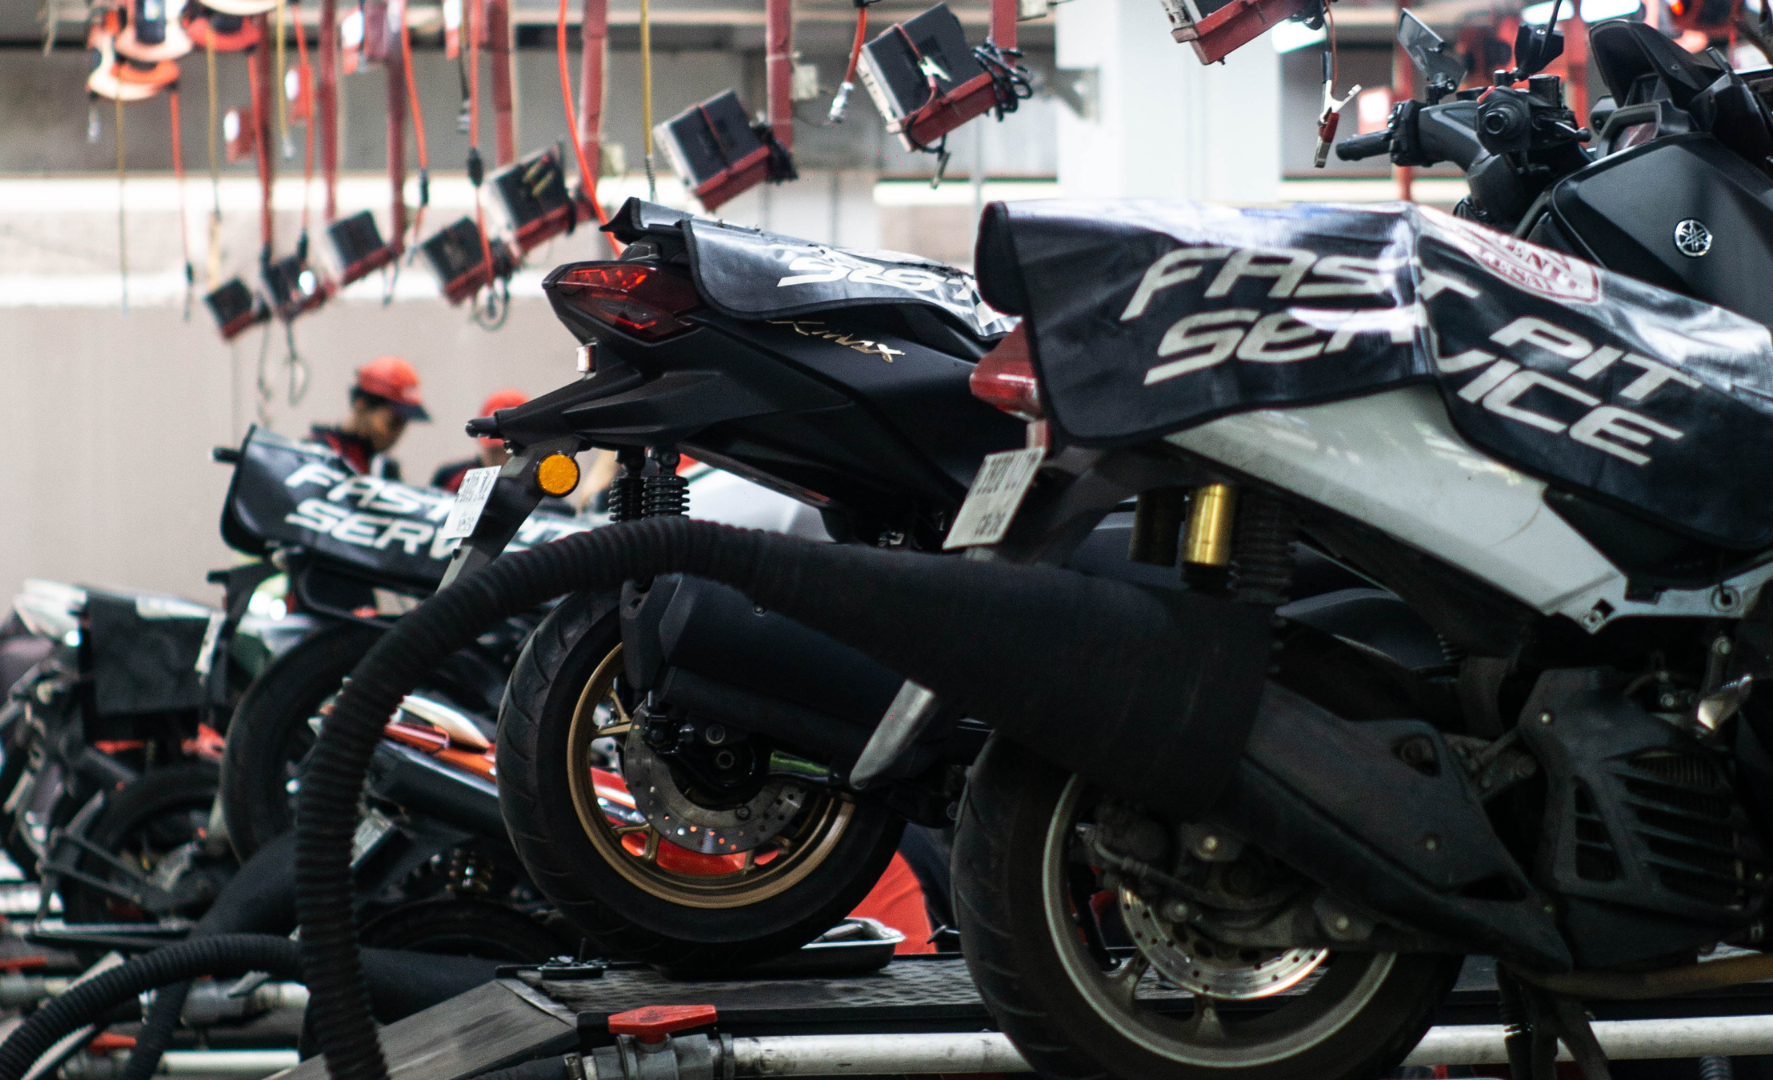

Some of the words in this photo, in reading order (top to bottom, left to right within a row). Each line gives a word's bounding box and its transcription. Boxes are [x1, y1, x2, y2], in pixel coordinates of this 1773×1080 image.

[1120, 247, 1481, 322] FAST
[1489, 315, 1702, 401] PIT
[284, 462, 457, 522] FAST
